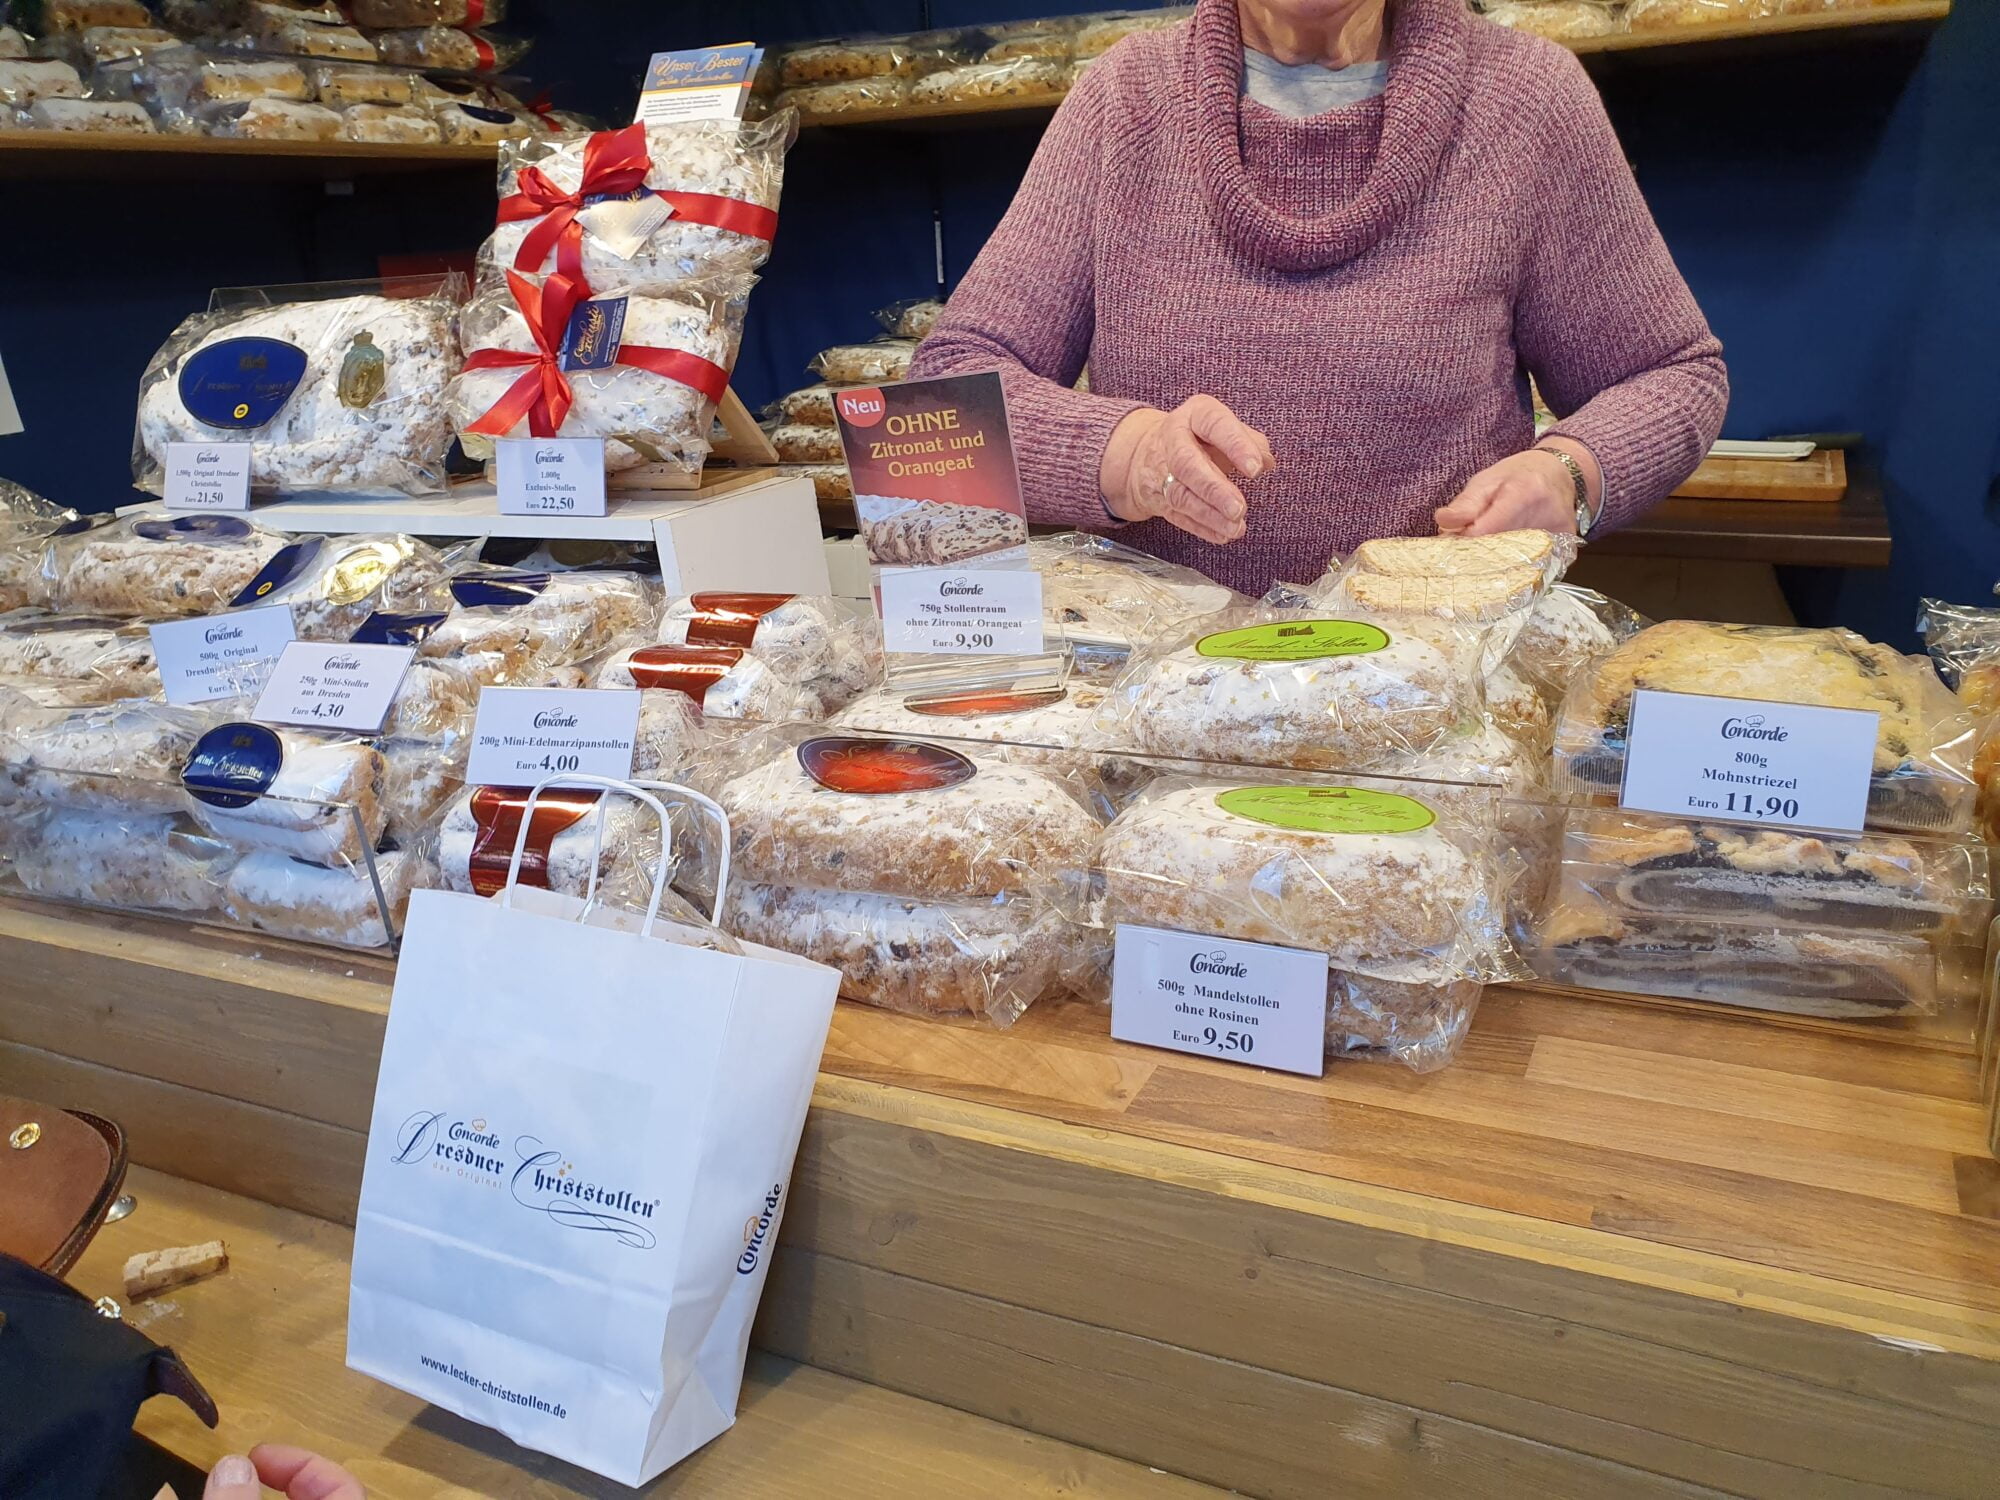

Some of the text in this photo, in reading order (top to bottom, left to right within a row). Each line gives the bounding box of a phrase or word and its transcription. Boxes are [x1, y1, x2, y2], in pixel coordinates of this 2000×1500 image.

[842, 398, 880, 416] Neu
[886, 408, 960, 436] OHNE
[869, 430, 986, 460] Zitronat und
[535, 451, 565, 464] Concorde
[888, 454, 976, 478] Orangeat
[196, 491, 224, 504] 21,50
[541, 496, 575, 512] 22,50
[939, 580, 984, 597] Concorde
[919, 604, 1007, 615] 750g Stollentraum
[905, 618, 929, 627] ohne
[976, 618, 1022, 629] Orangeat
[204, 627, 244, 645] Concorde
[932, 633, 994, 651] Euro 9,90
[199, 645, 259, 662] 500g Original
[324, 655, 361, 671] Concorde
[299, 675, 370, 689] 250g Mini-Stollen
[300, 689, 351, 699] aus Dresden
[291, 702, 345, 719] Euro 4,30
[533, 711, 578, 729] Concorde
[1720, 716, 1789, 742] Concorde
[479, 736, 630, 750] 200g Mini-Edelmarzipanstollen
[516, 754, 580, 774] Euro 4,00
[1734, 751, 1768, 769] 800g
[1701, 768, 1798, 790] Mohnstriezel
[1688, 792, 1800, 819] Euro 11,90
[1189, 952, 1248, 978] Concorde
[1157, 978, 1281, 1009] 500g Mandelstollen
[1174, 1002, 1260, 1026] ohne Rosinen
[1172, 1027, 1254, 1053] Euro 9,50
[391, 1110, 505, 1176] Dresdner
[448, 1121, 501, 1150] Concorde
[736, 1183, 783, 1276] Concorde
[420, 1355, 567, 1420] www.lecker-christstollen.de
